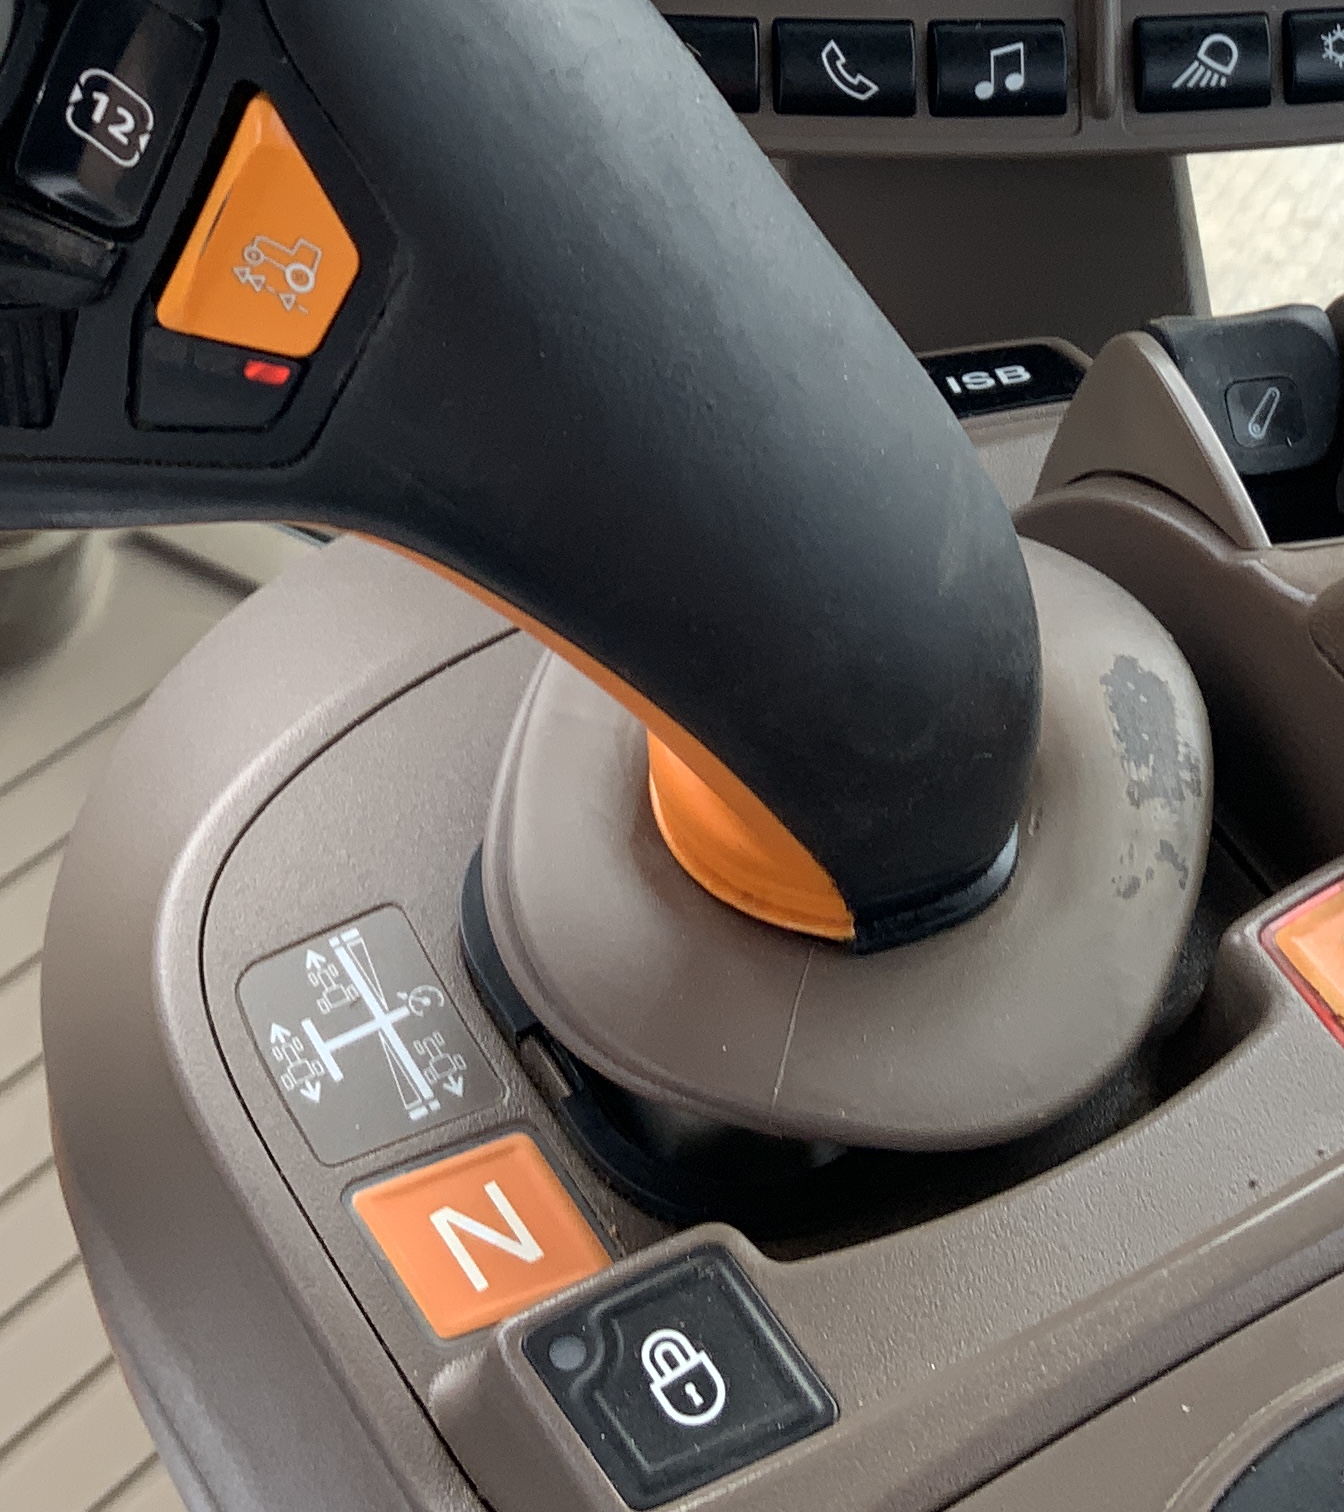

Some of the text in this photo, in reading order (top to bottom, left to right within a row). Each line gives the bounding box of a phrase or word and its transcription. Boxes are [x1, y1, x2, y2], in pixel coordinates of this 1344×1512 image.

[92, 90, 135, 144] 12
[946, 364, 1032, 394] ISB
[429, 1180, 544, 1291] N
